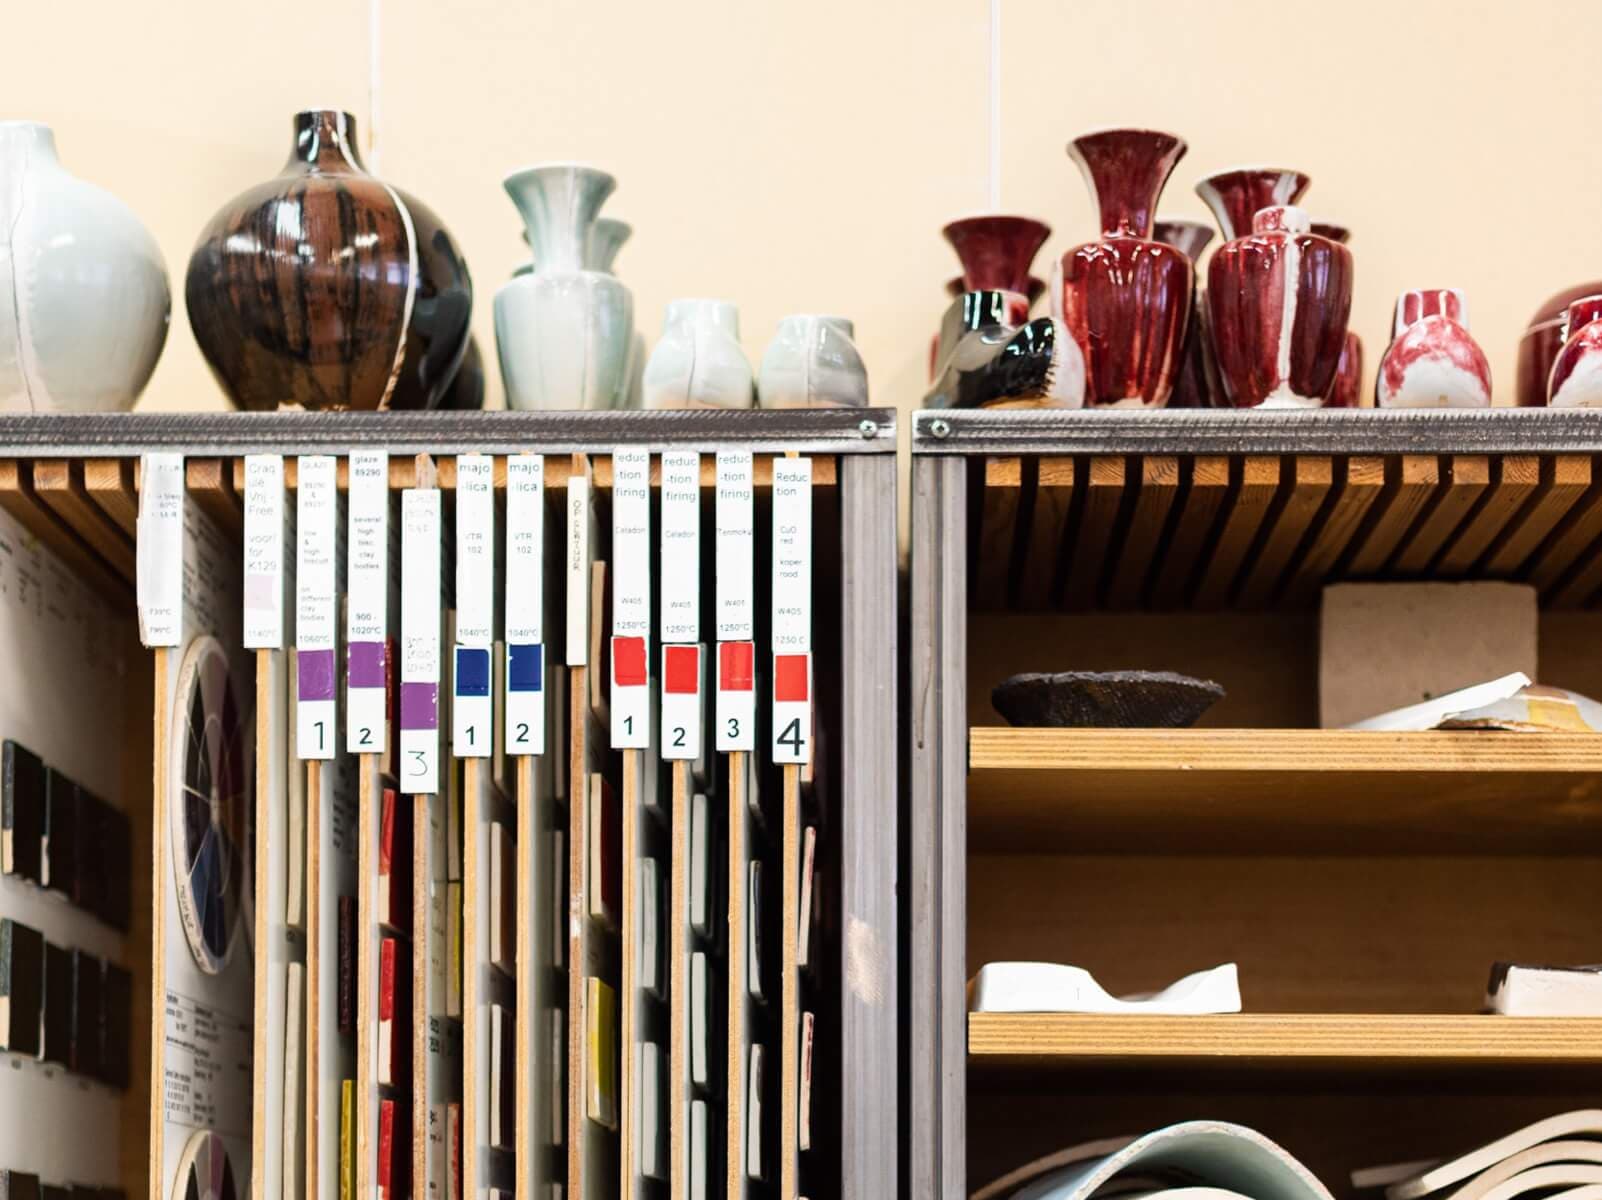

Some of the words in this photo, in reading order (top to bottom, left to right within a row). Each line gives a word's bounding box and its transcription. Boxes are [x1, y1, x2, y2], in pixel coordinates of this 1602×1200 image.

[354, 455, 379, 465] glaze
[664, 456, 697, 467] reduc
[719, 454, 750, 464] reduc
[459, 464, 490, 475] majo
[509, 464, 539, 474] majo
[666, 474, 692, 484] -tion
[719, 471, 746, 482] -tion
[777, 472, 807, 482] Reduc
[616, 488, 645, 499] firing
[666, 491, 696, 503] firing
[720, 489, 750, 500] firing
[776, 487, 797, 497] tion
[357, 527, 375, 537] high
[624, 716, 632, 735] 1
[728, 718, 739, 738] 3
[314, 722, 323, 750] 1
[360, 728, 372, 744] 2
[466, 726, 474, 745] 1
[517, 723, 528, 742] 2
[673, 728, 685, 746] 2
[777, 718, 805, 756] 4
[408, 751, 427, 776] 3
